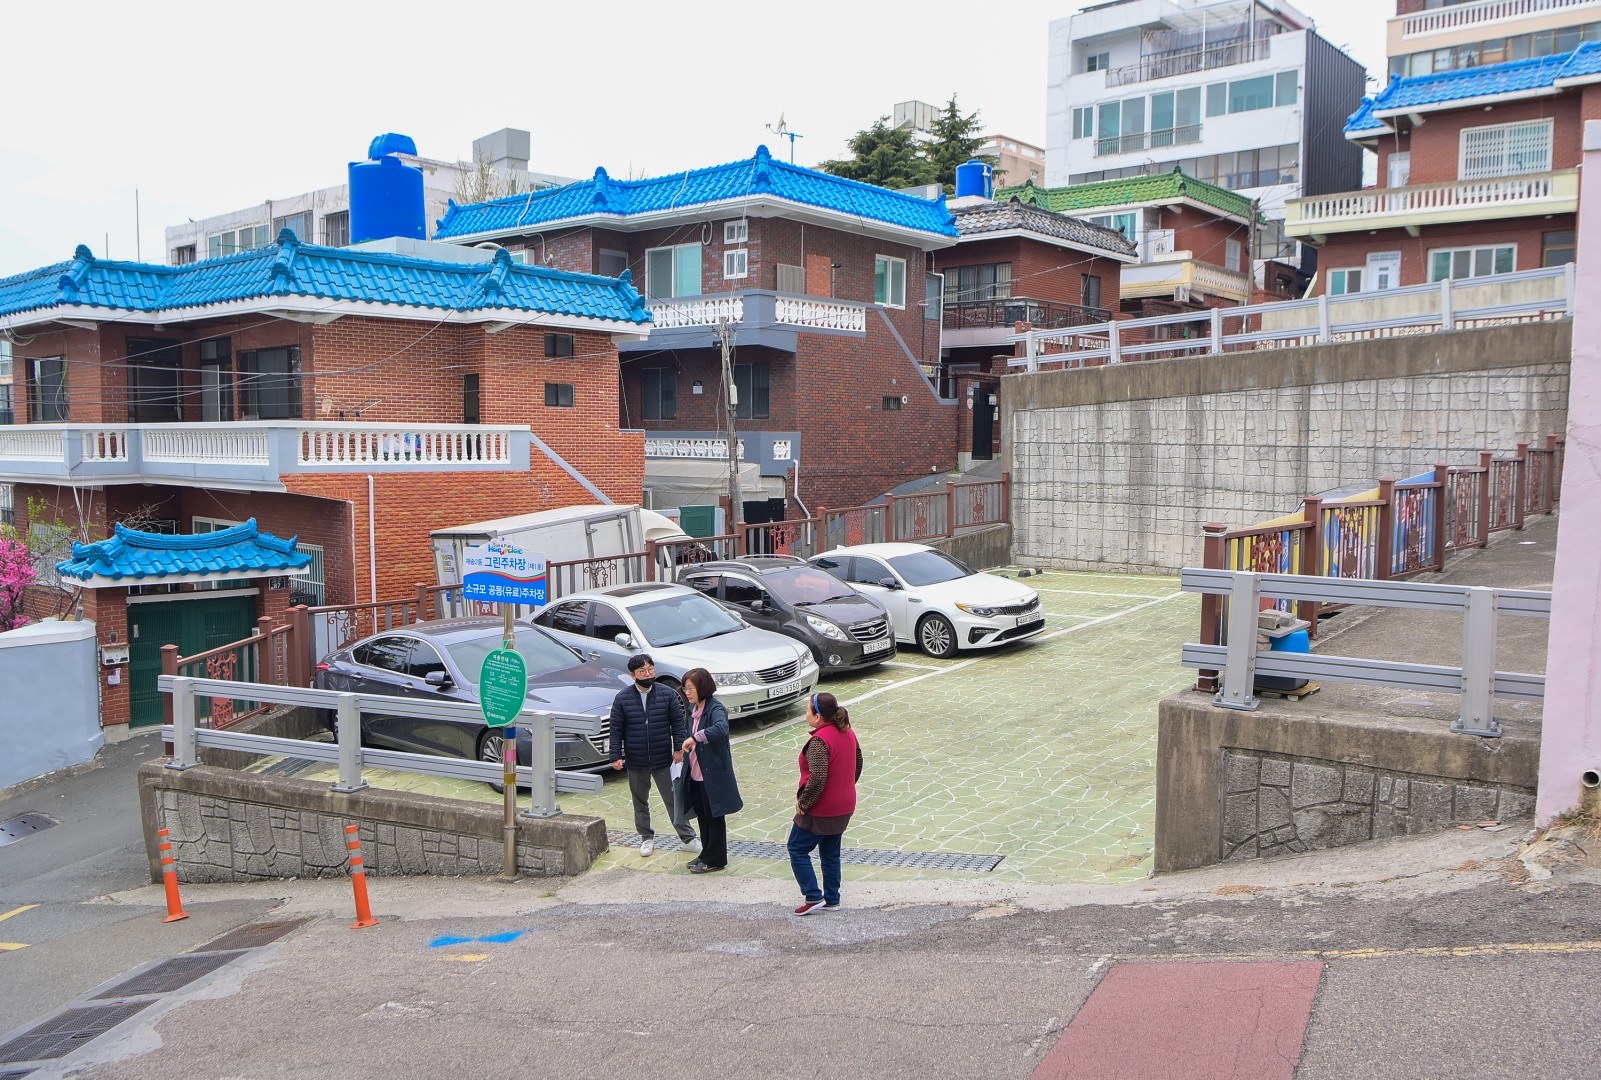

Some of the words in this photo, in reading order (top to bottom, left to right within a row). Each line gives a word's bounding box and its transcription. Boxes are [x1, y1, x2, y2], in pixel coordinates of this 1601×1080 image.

[465, 558, 483, 566] 재송2동
[484, 556, 526, 571] 그린주차장
[465, 583, 486, 594] 소규모
[488, 585, 545, 600] 공동(유료)주차장
